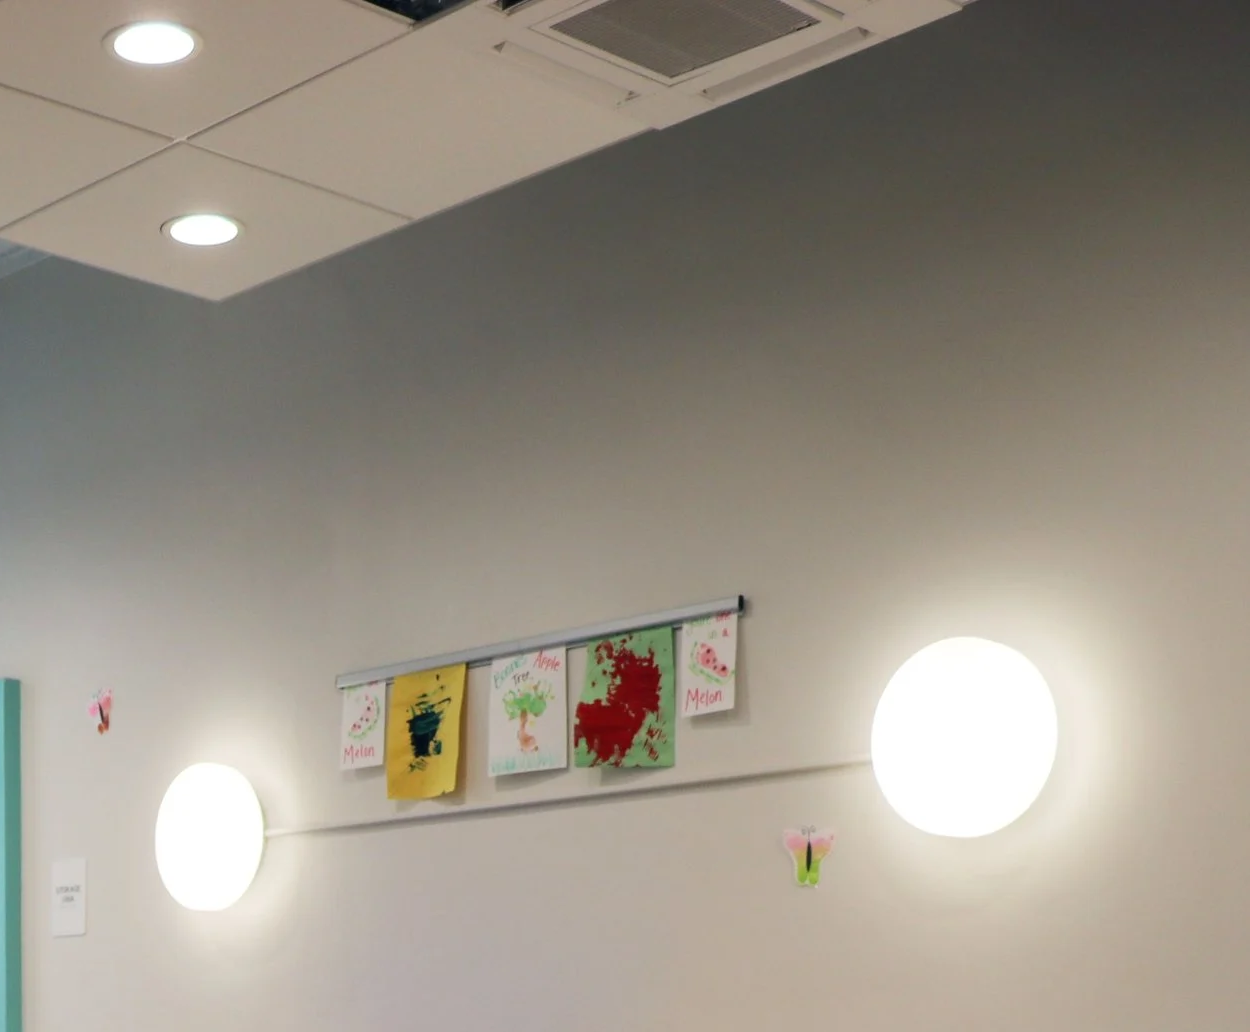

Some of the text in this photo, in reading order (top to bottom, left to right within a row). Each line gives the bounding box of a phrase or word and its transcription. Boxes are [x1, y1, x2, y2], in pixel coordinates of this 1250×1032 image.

[533, 648, 561, 671] Apple
[684, 687, 722, 712] Melon
[343, 743, 375, 765] Melon
